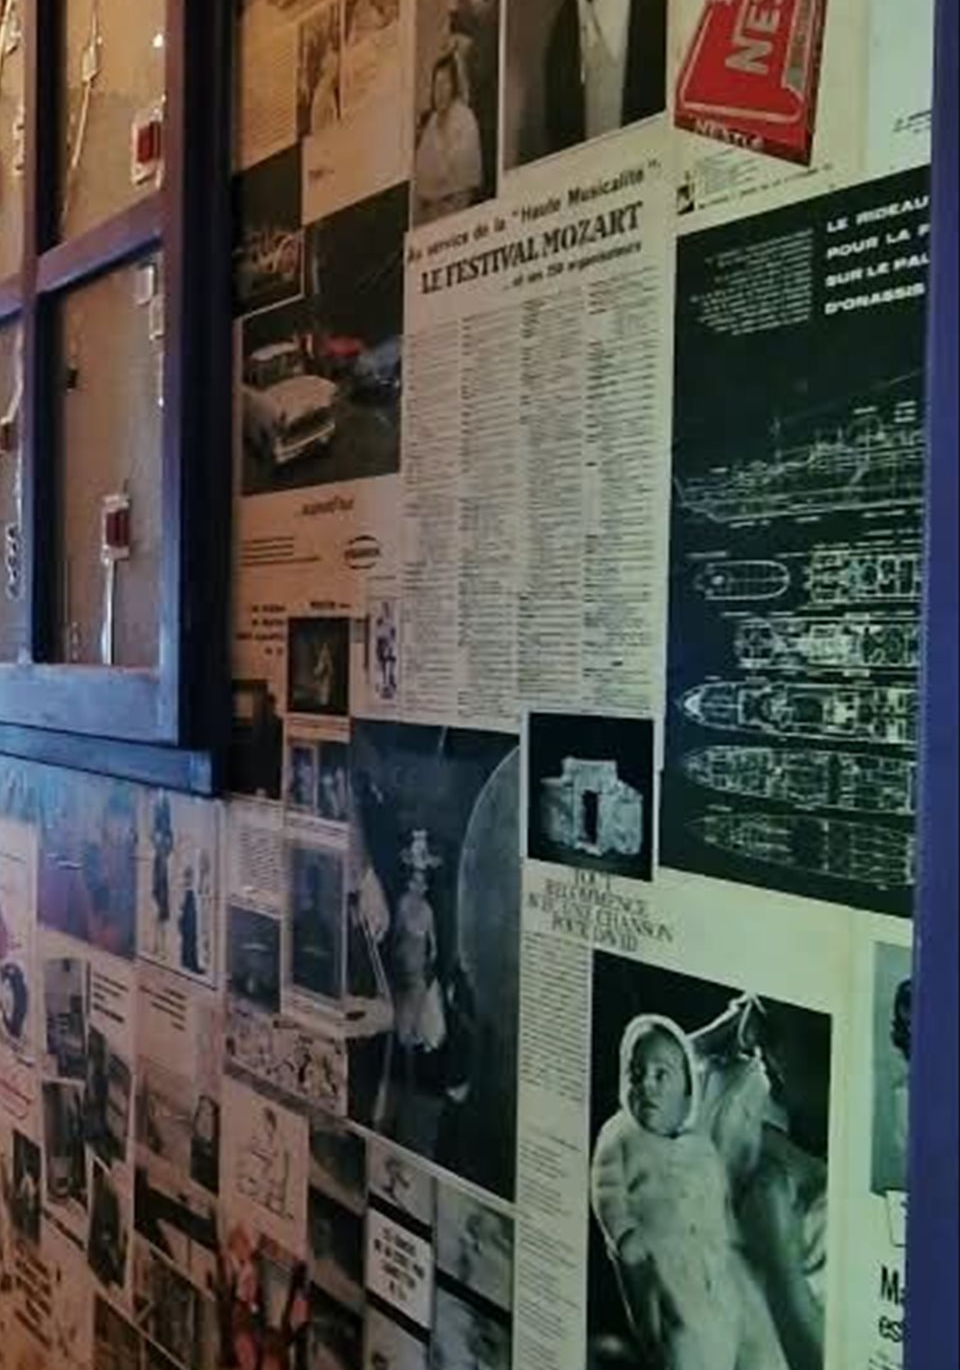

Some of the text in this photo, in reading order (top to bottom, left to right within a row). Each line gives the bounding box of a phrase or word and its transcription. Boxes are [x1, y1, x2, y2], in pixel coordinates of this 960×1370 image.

[827, 195, 929, 234] LE RIDEAU
[420, 200, 644, 296] LE FESTIVAL MOZART
[472, 221, 490, 242] de
[826, 235, 879, 260] POUR
[885, 227, 911, 245] LA
[824, 269, 863, 289] SUR
[866, 260, 889, 278] LE
[824, 282, 925, 315] D'ONASSIS
